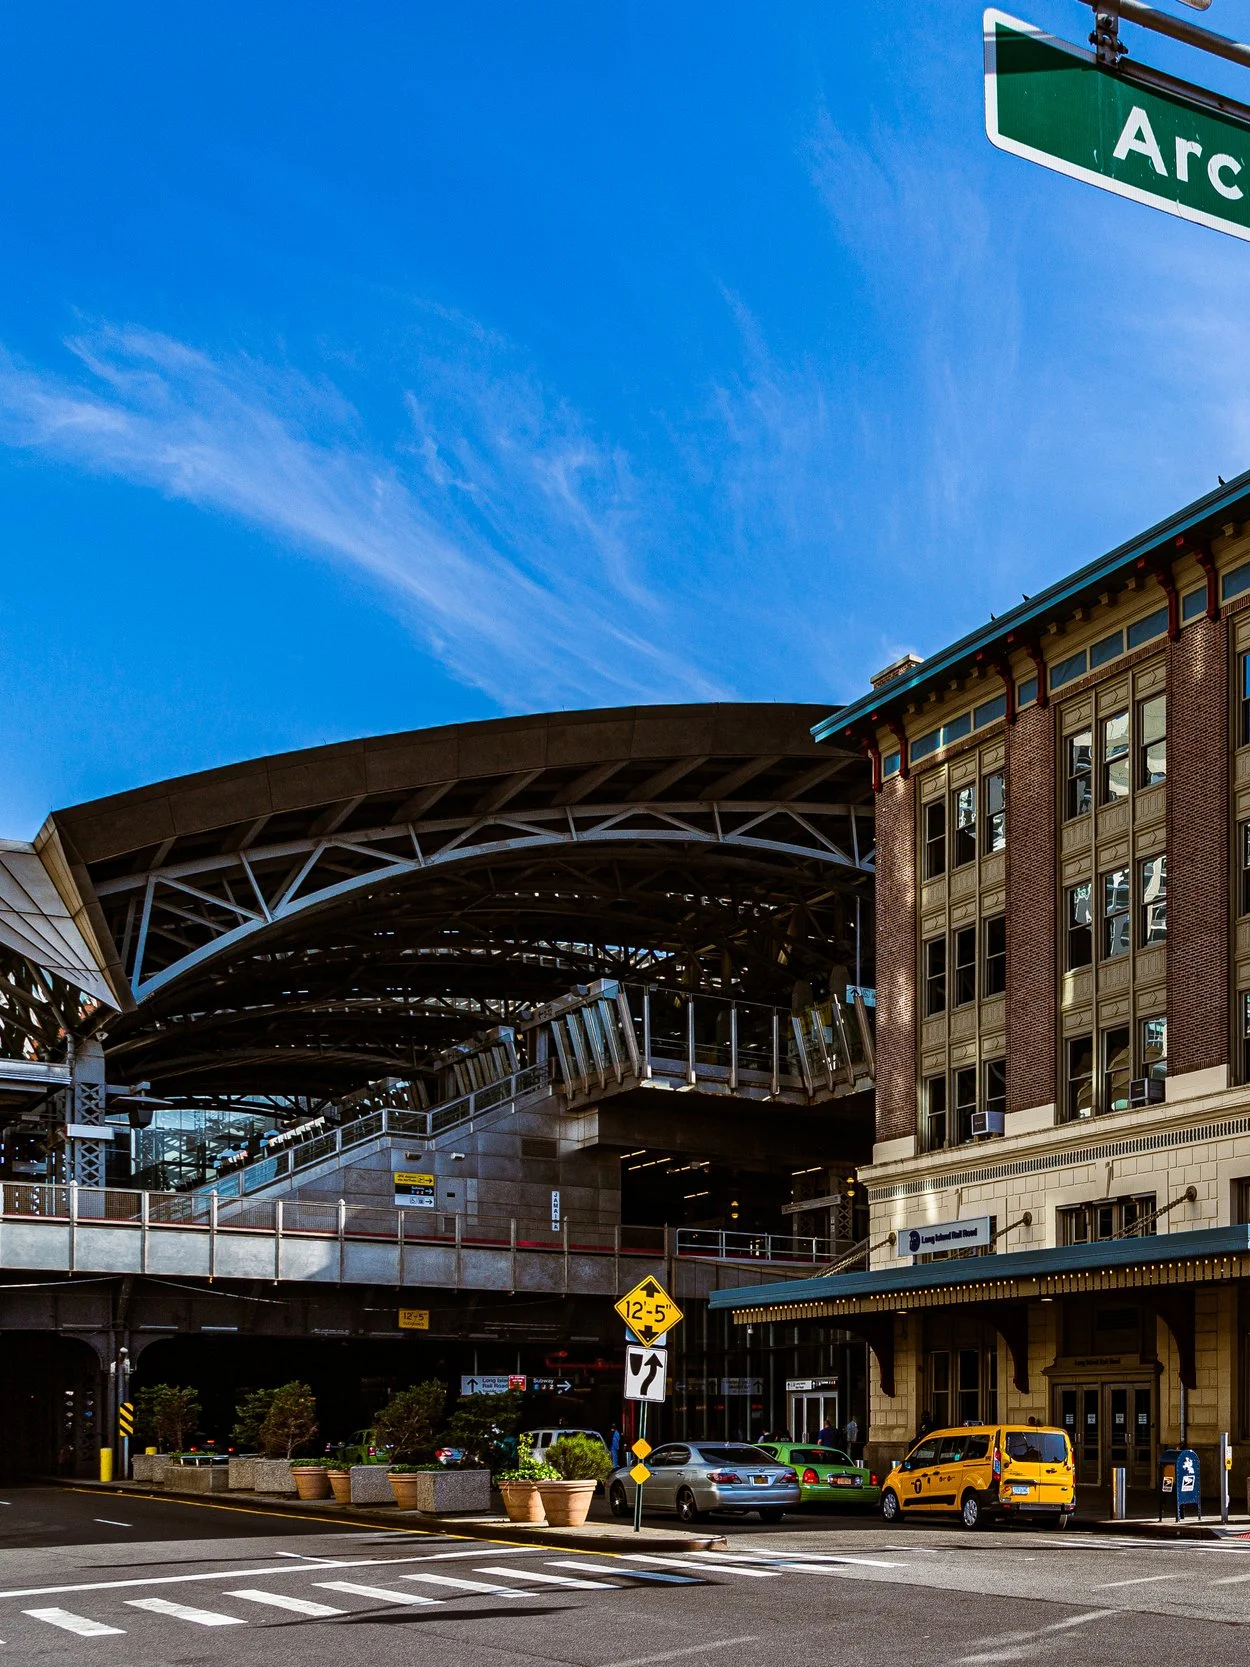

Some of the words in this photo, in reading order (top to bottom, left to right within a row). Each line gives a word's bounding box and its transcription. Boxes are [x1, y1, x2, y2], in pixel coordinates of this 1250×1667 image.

[921, 1236, 935, 1244] Long
[935, 1232, 951, 1242] Island
[951, 1230, 962, 1239] Rail
[962, 1228, 977, 1238] Road
[626, 1300, 671, 1323] 12'-5"
